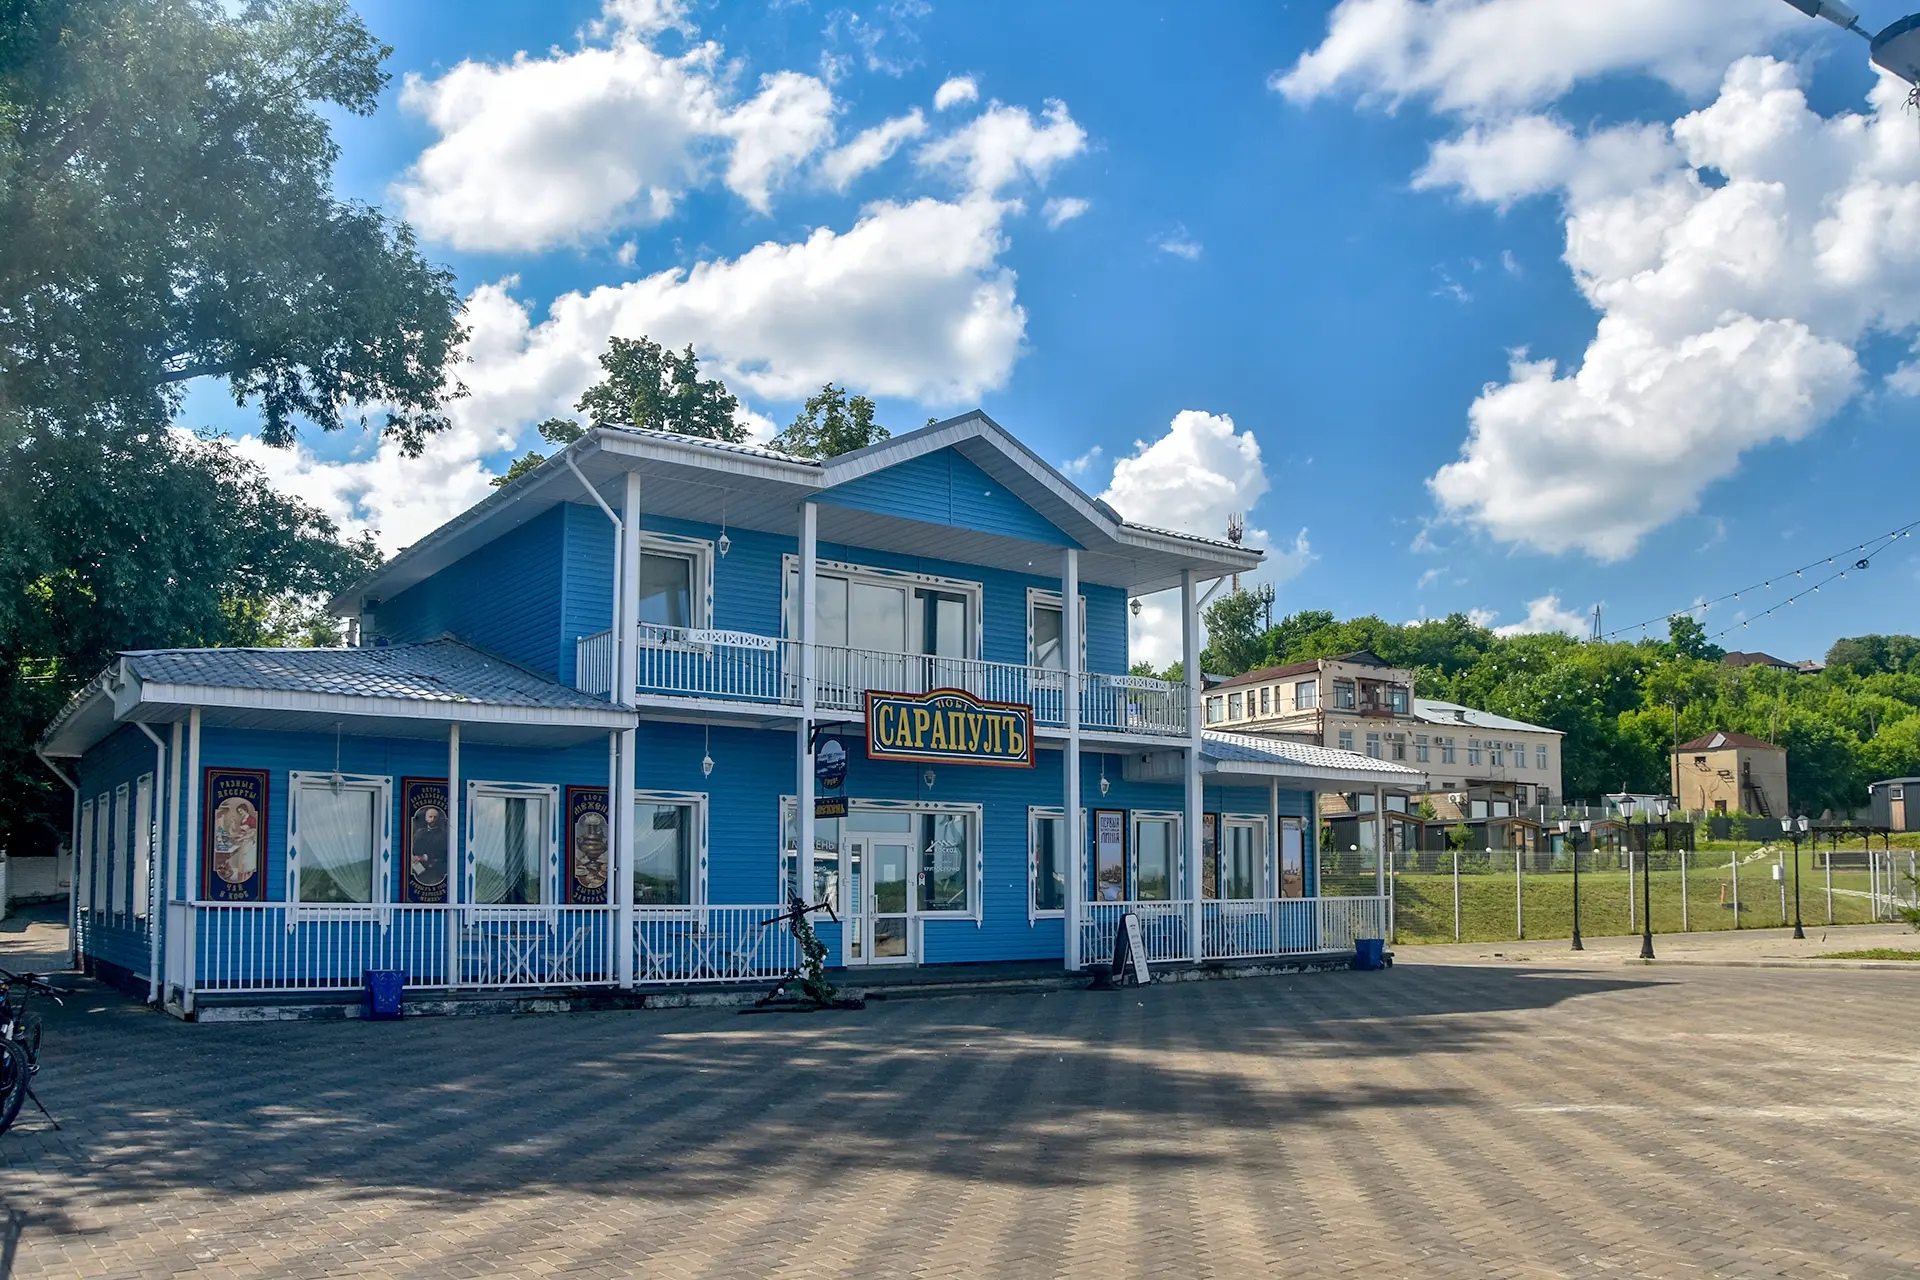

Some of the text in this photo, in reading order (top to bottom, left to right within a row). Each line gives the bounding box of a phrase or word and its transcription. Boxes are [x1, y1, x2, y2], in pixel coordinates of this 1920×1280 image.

[879, 704, 1025, 755] САРАПУЛЪ
[219, 779, 255, 790] РАЗНЫЕ
[217, 788, 257, 799] ДЕСЕРТЫ
[583, 794, 602, 802] КАФЕ
[574, 801, 609, 816] МЕЖЕН
[226, 883, 244, 891] ЧАЙ
[219, 890, 249, 900] И КОФЕ
